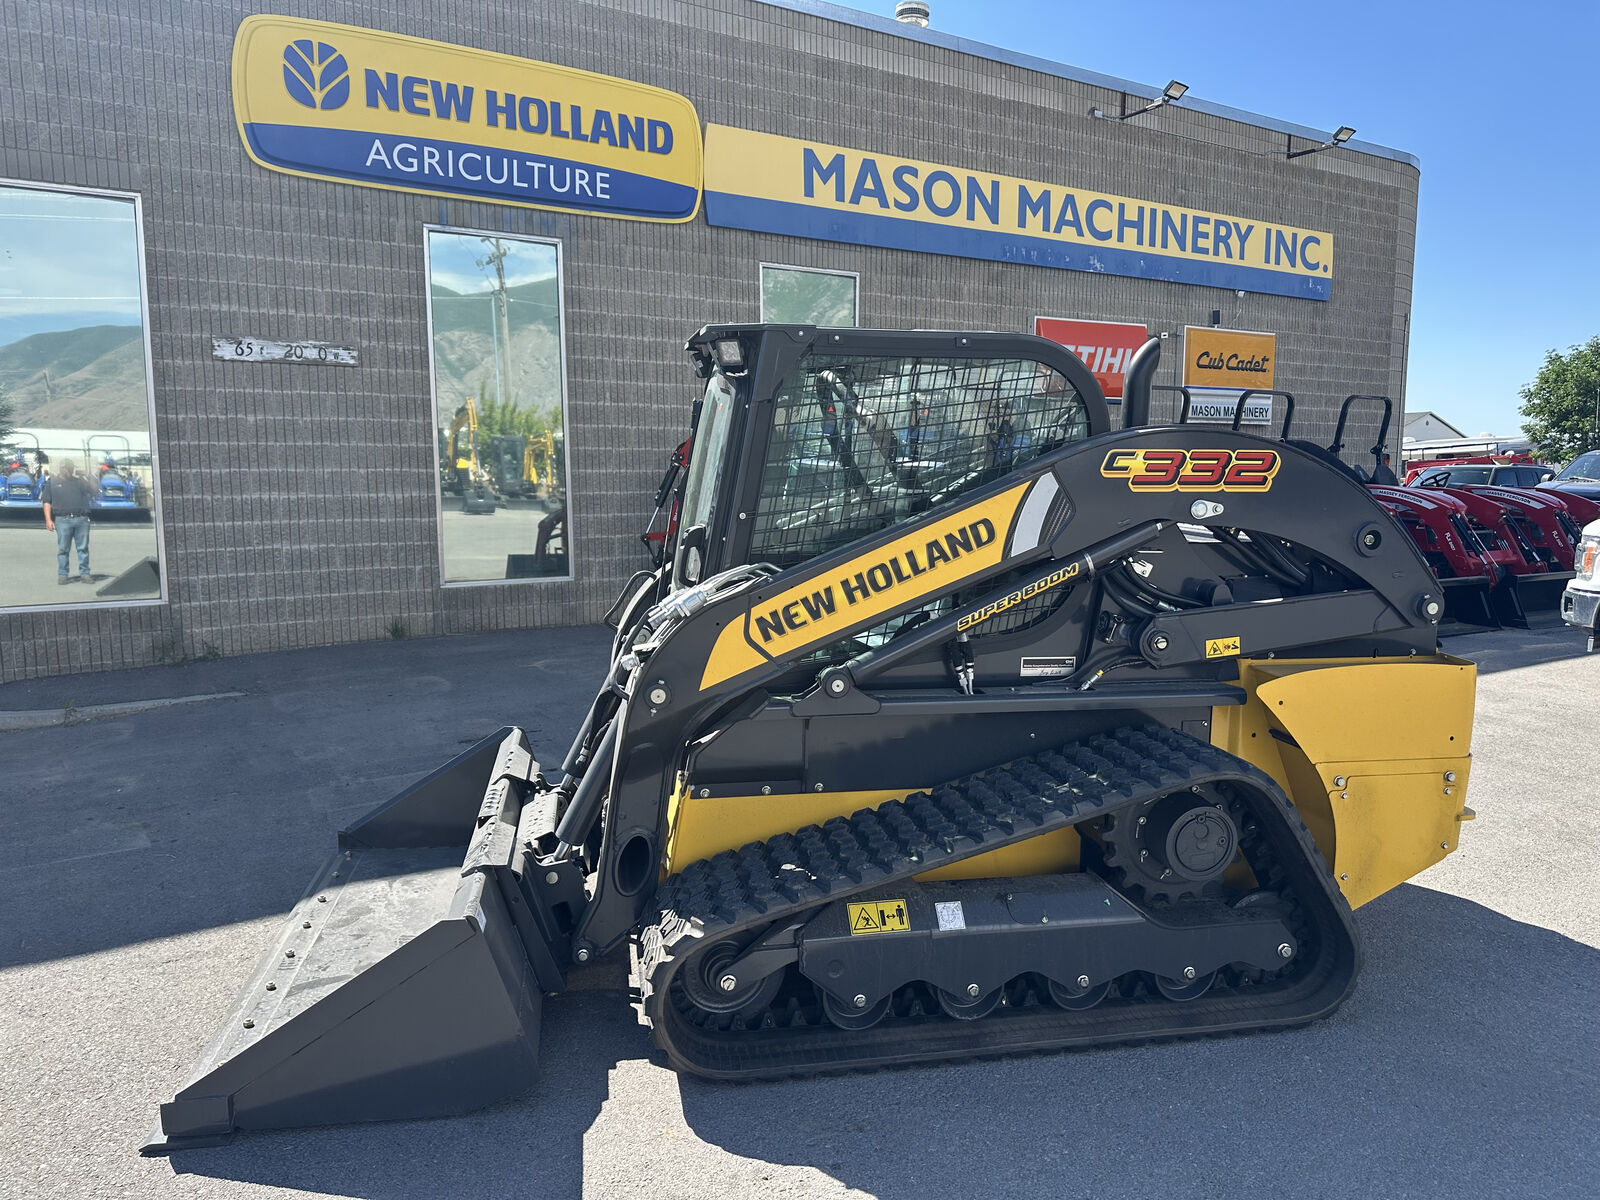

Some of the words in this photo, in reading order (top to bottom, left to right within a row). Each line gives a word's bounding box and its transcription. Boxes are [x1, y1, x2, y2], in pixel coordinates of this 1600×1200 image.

[365, 68, 474, 123] NEW
[486, 90, 674, 156] HOLLAND
[365, 139, 611, 200] AGRICULTURE
[802, 148, 1001, 226] MASON
[1017, 185, 1255, 262] MACHINERY
[1263, 227, 1330, 274] INC.
[1196, 351, 1224, 370] Cub
[1226, 353, 1269, 373] Cadet
[1191, 405, 1221, 417] MASON
[1223, 406, 1270, 418] MAHINERY
[1100, 449, 1282, 493] C332
[754, 585, 838, 644] NEW
[840, 517, 996, 606] HOLLAND
[957, 592, 1022, 632] SUPER
[1022, 563, 1079, 600] BOOM
